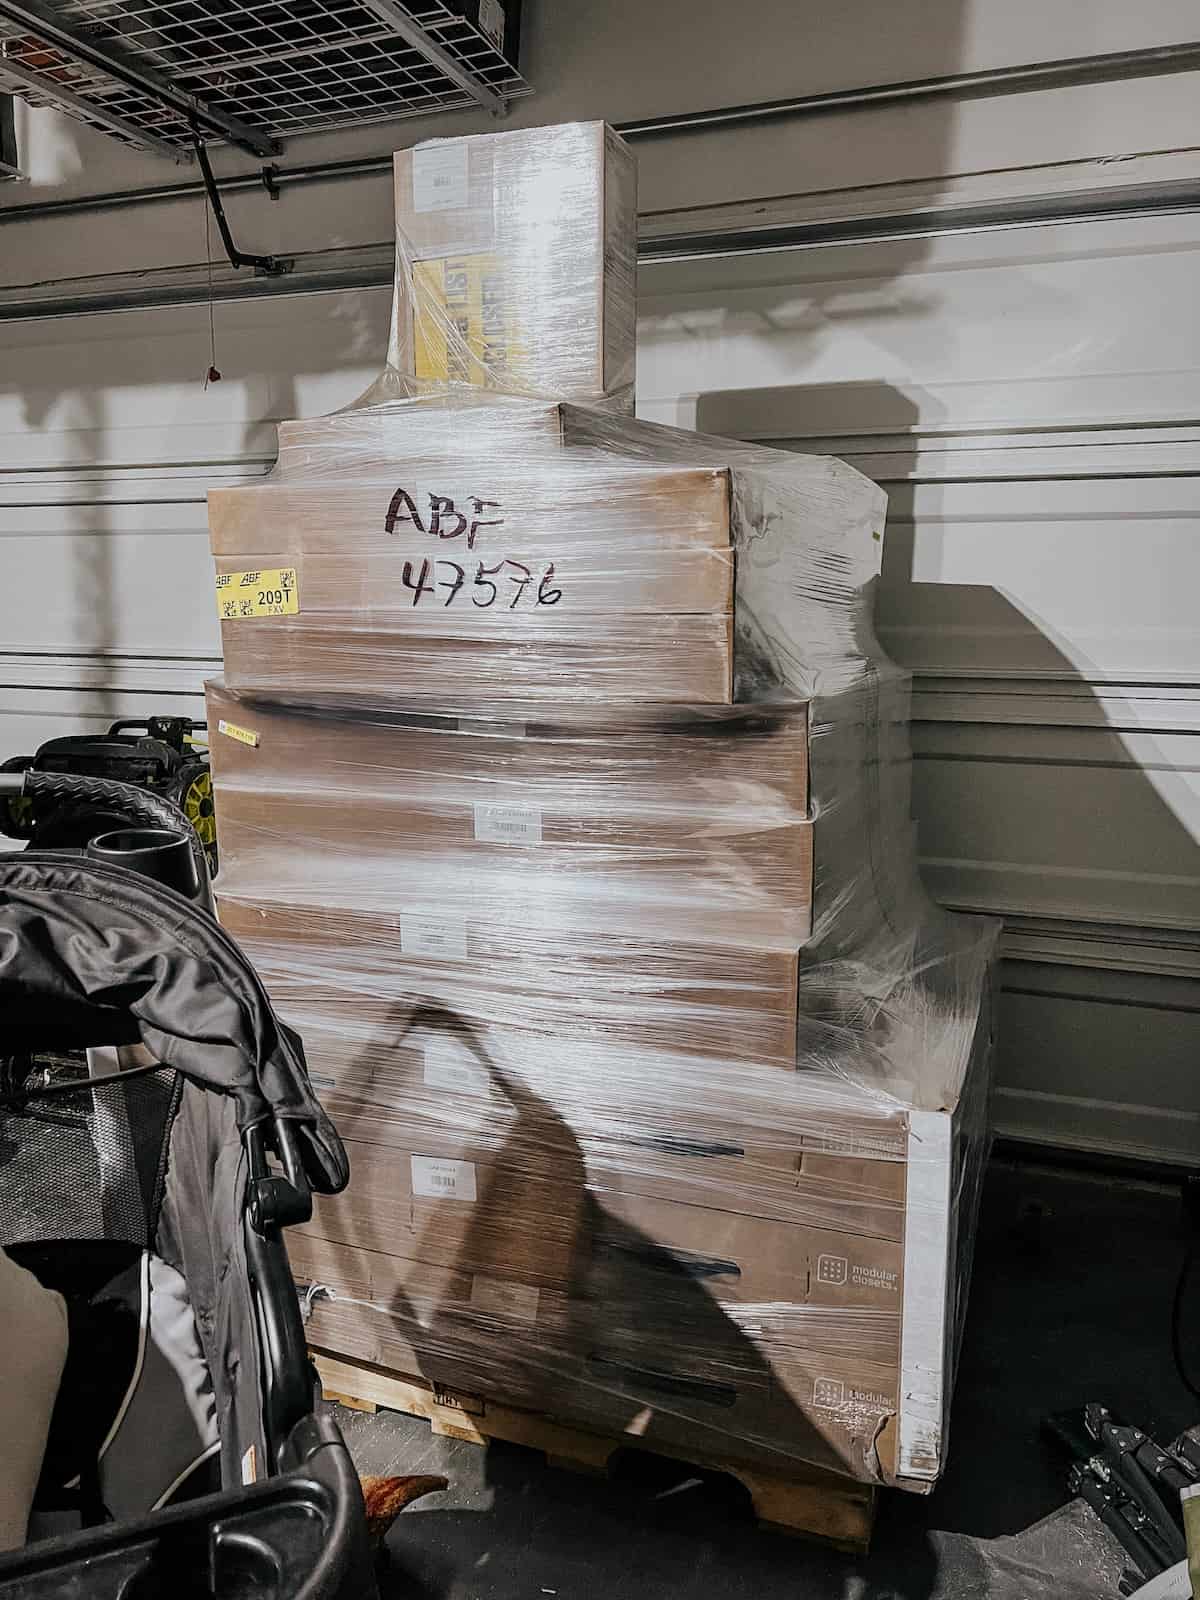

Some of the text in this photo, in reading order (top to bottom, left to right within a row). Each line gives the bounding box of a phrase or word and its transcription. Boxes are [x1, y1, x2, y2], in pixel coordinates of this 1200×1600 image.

[384, 487, 504, 549] ABF
[241, 572, 261, 584] ABF
[402, 558, 562, 608] 47576
[258, 589, 291, 605] 209T
[852, 1265, 897, 1281] modular
